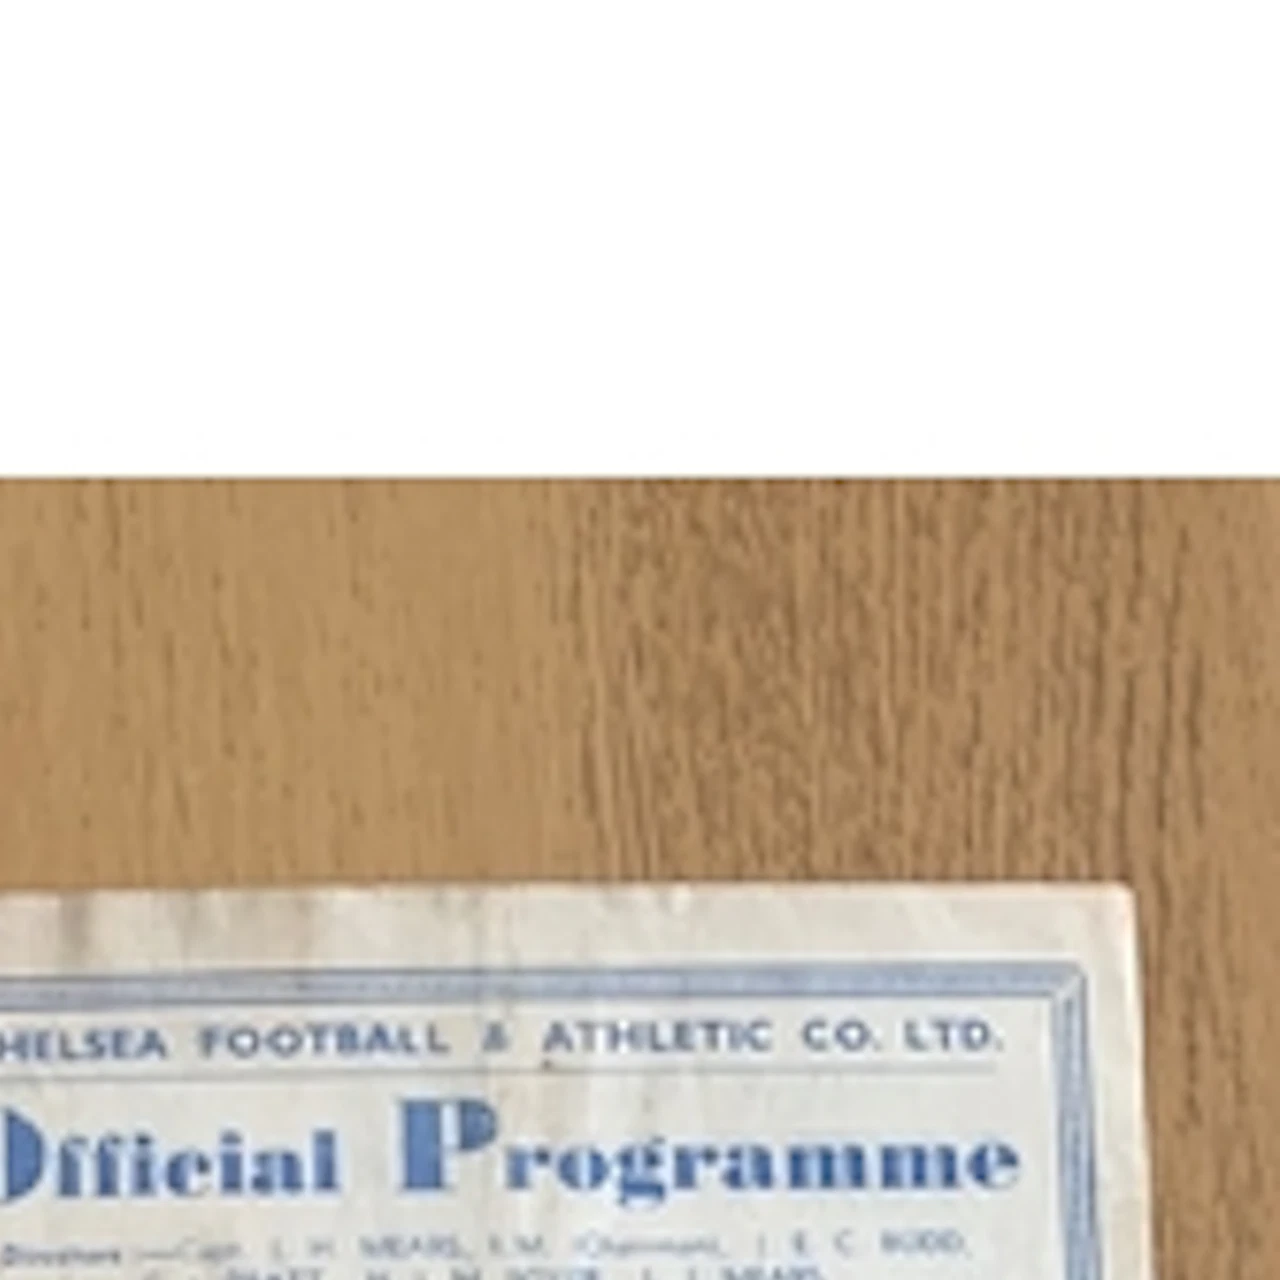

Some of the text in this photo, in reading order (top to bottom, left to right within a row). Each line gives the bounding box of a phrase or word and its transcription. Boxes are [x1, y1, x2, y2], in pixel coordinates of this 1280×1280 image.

[198, 1022, 449, 1059] FOOTBALL
[542, 1019, 771, 1053] ATHLETIC
[800, 1018, 885, 1052] CO.
[904, 1018, 1006, 1052] LTD.
[400, 1098, 1020, 1206] Programme
